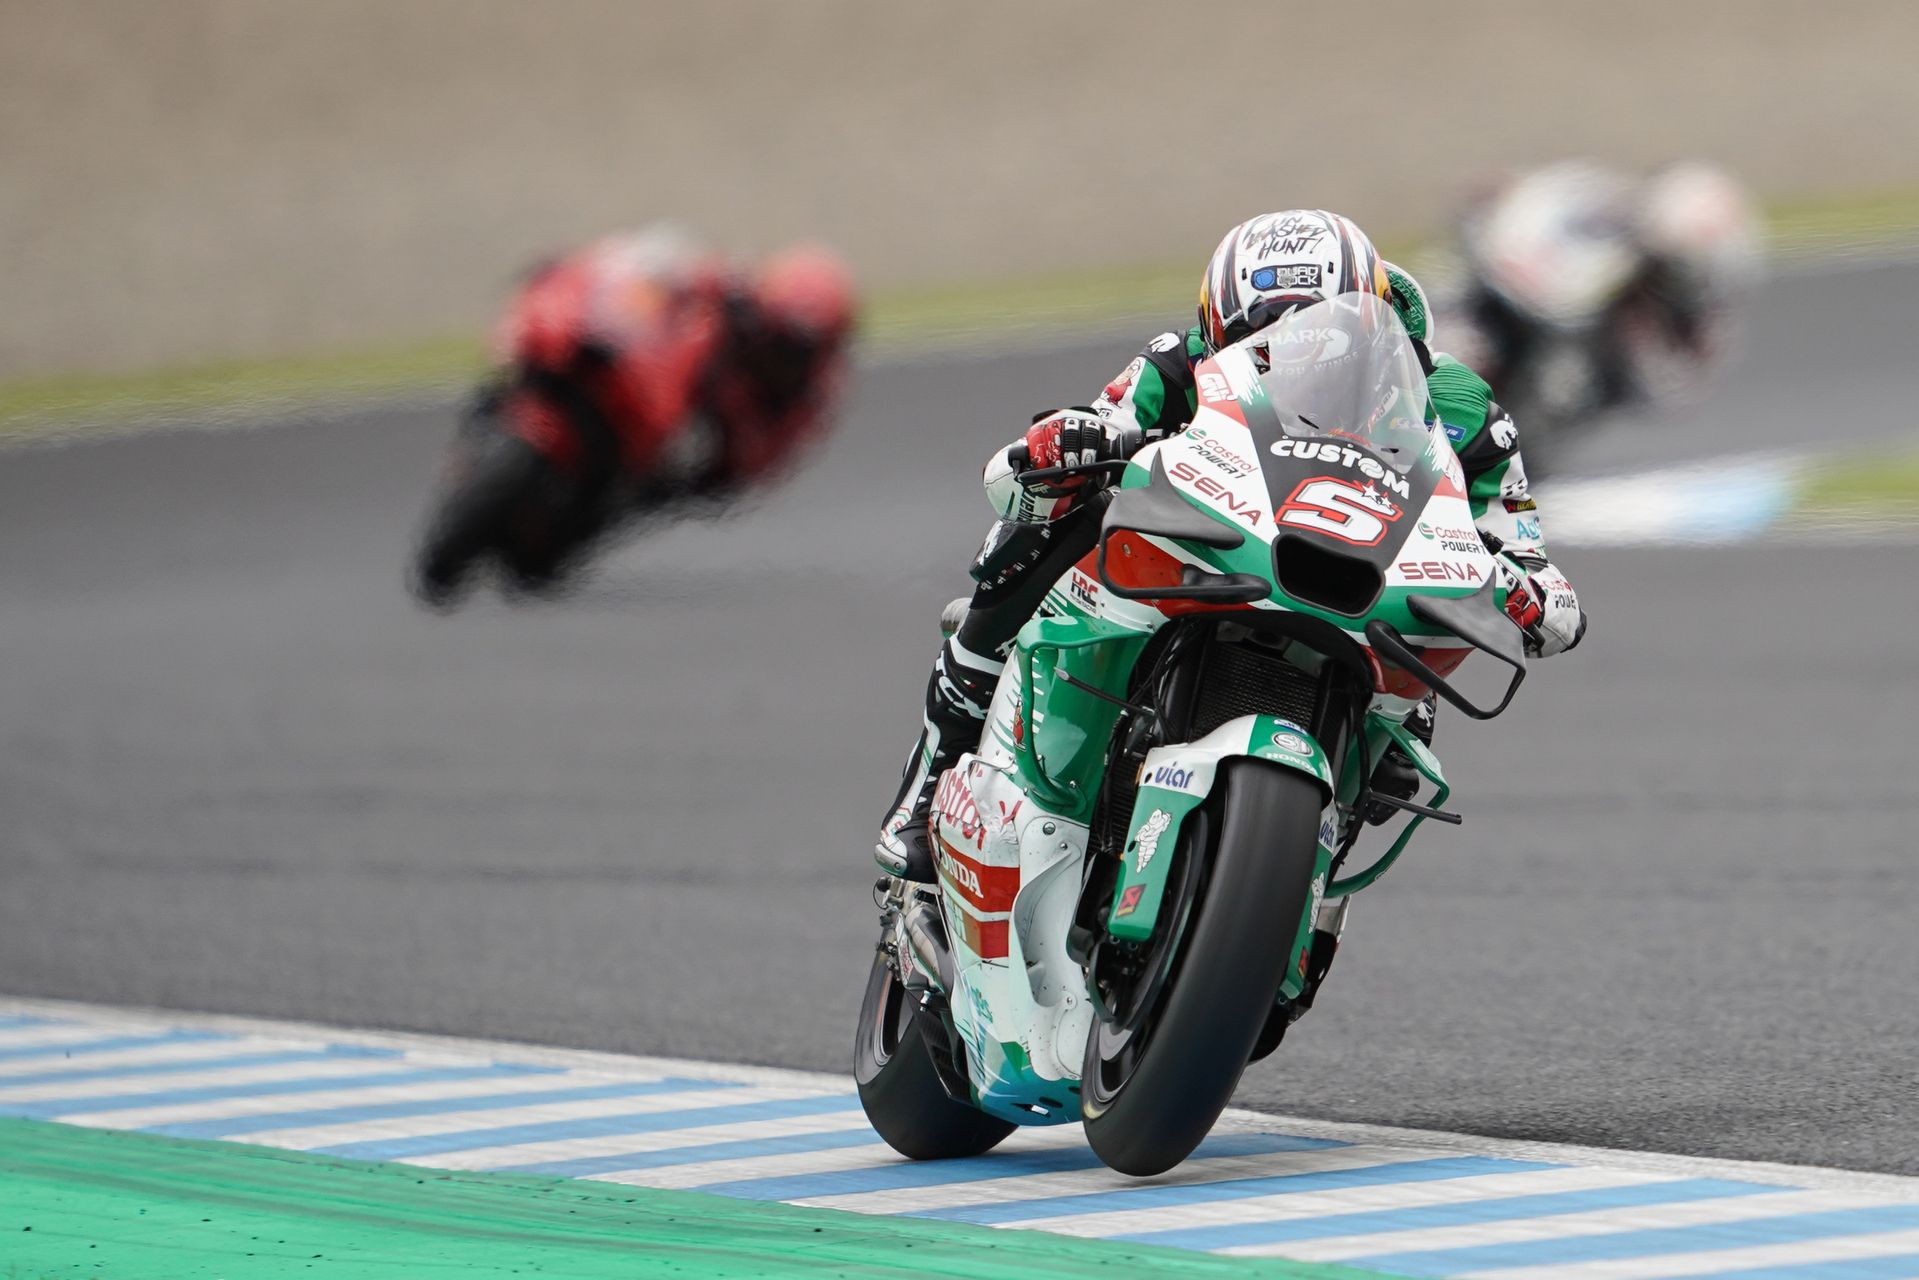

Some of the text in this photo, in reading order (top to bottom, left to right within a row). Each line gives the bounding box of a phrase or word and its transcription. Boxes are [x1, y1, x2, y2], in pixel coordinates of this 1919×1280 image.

[1258, 236, 1324, 260] HUNT!
[1199, 437, 1259, 473] Castrol
[1270, 436, 1410, 499] CUSTOM
[1169, 461, 1263, 527] SENA
[1275, 476, 1404, 546] 5
[1435, 526, 1478, 541] Castrol
[1398, 561, 1484, 583] SENA
[1154, 762, 1194, 789] viar
[939, 847, 985, 899] ONDA
